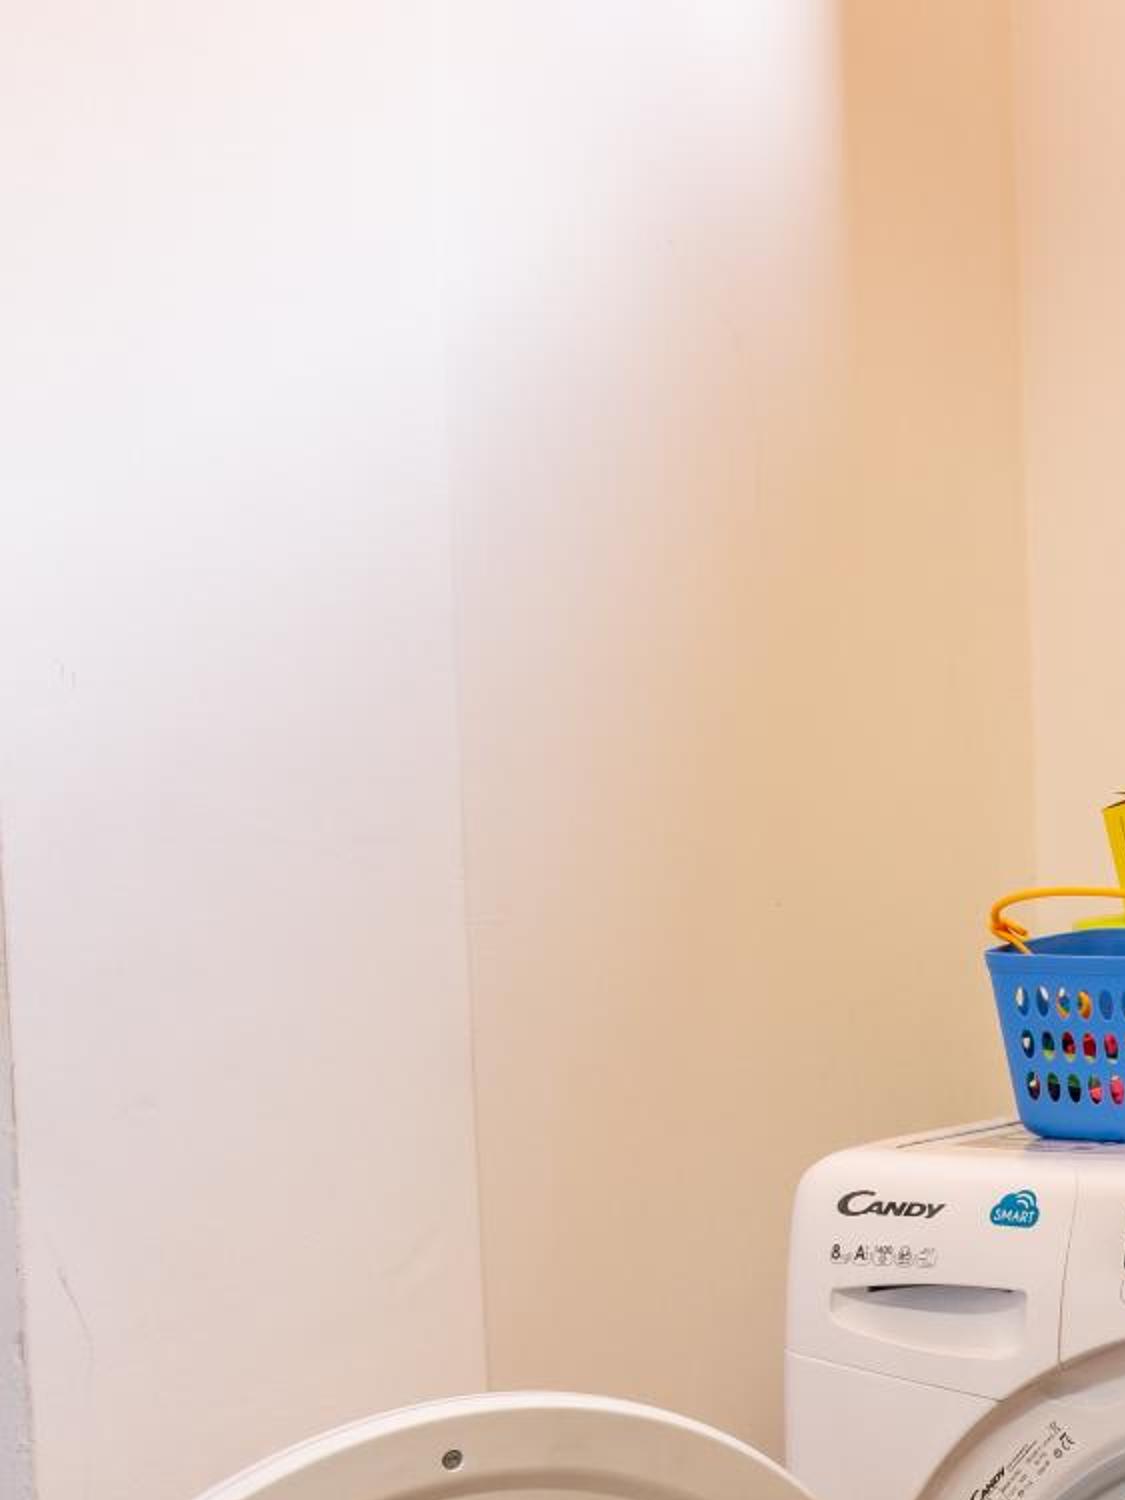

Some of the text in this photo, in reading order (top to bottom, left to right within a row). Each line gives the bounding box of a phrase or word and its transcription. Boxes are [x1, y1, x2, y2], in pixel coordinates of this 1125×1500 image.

[837, 1190, 946, 1219] CANDY
[993, 1207, 1036, 1224] SMART
[831, 1243, 841, 1260] 8
